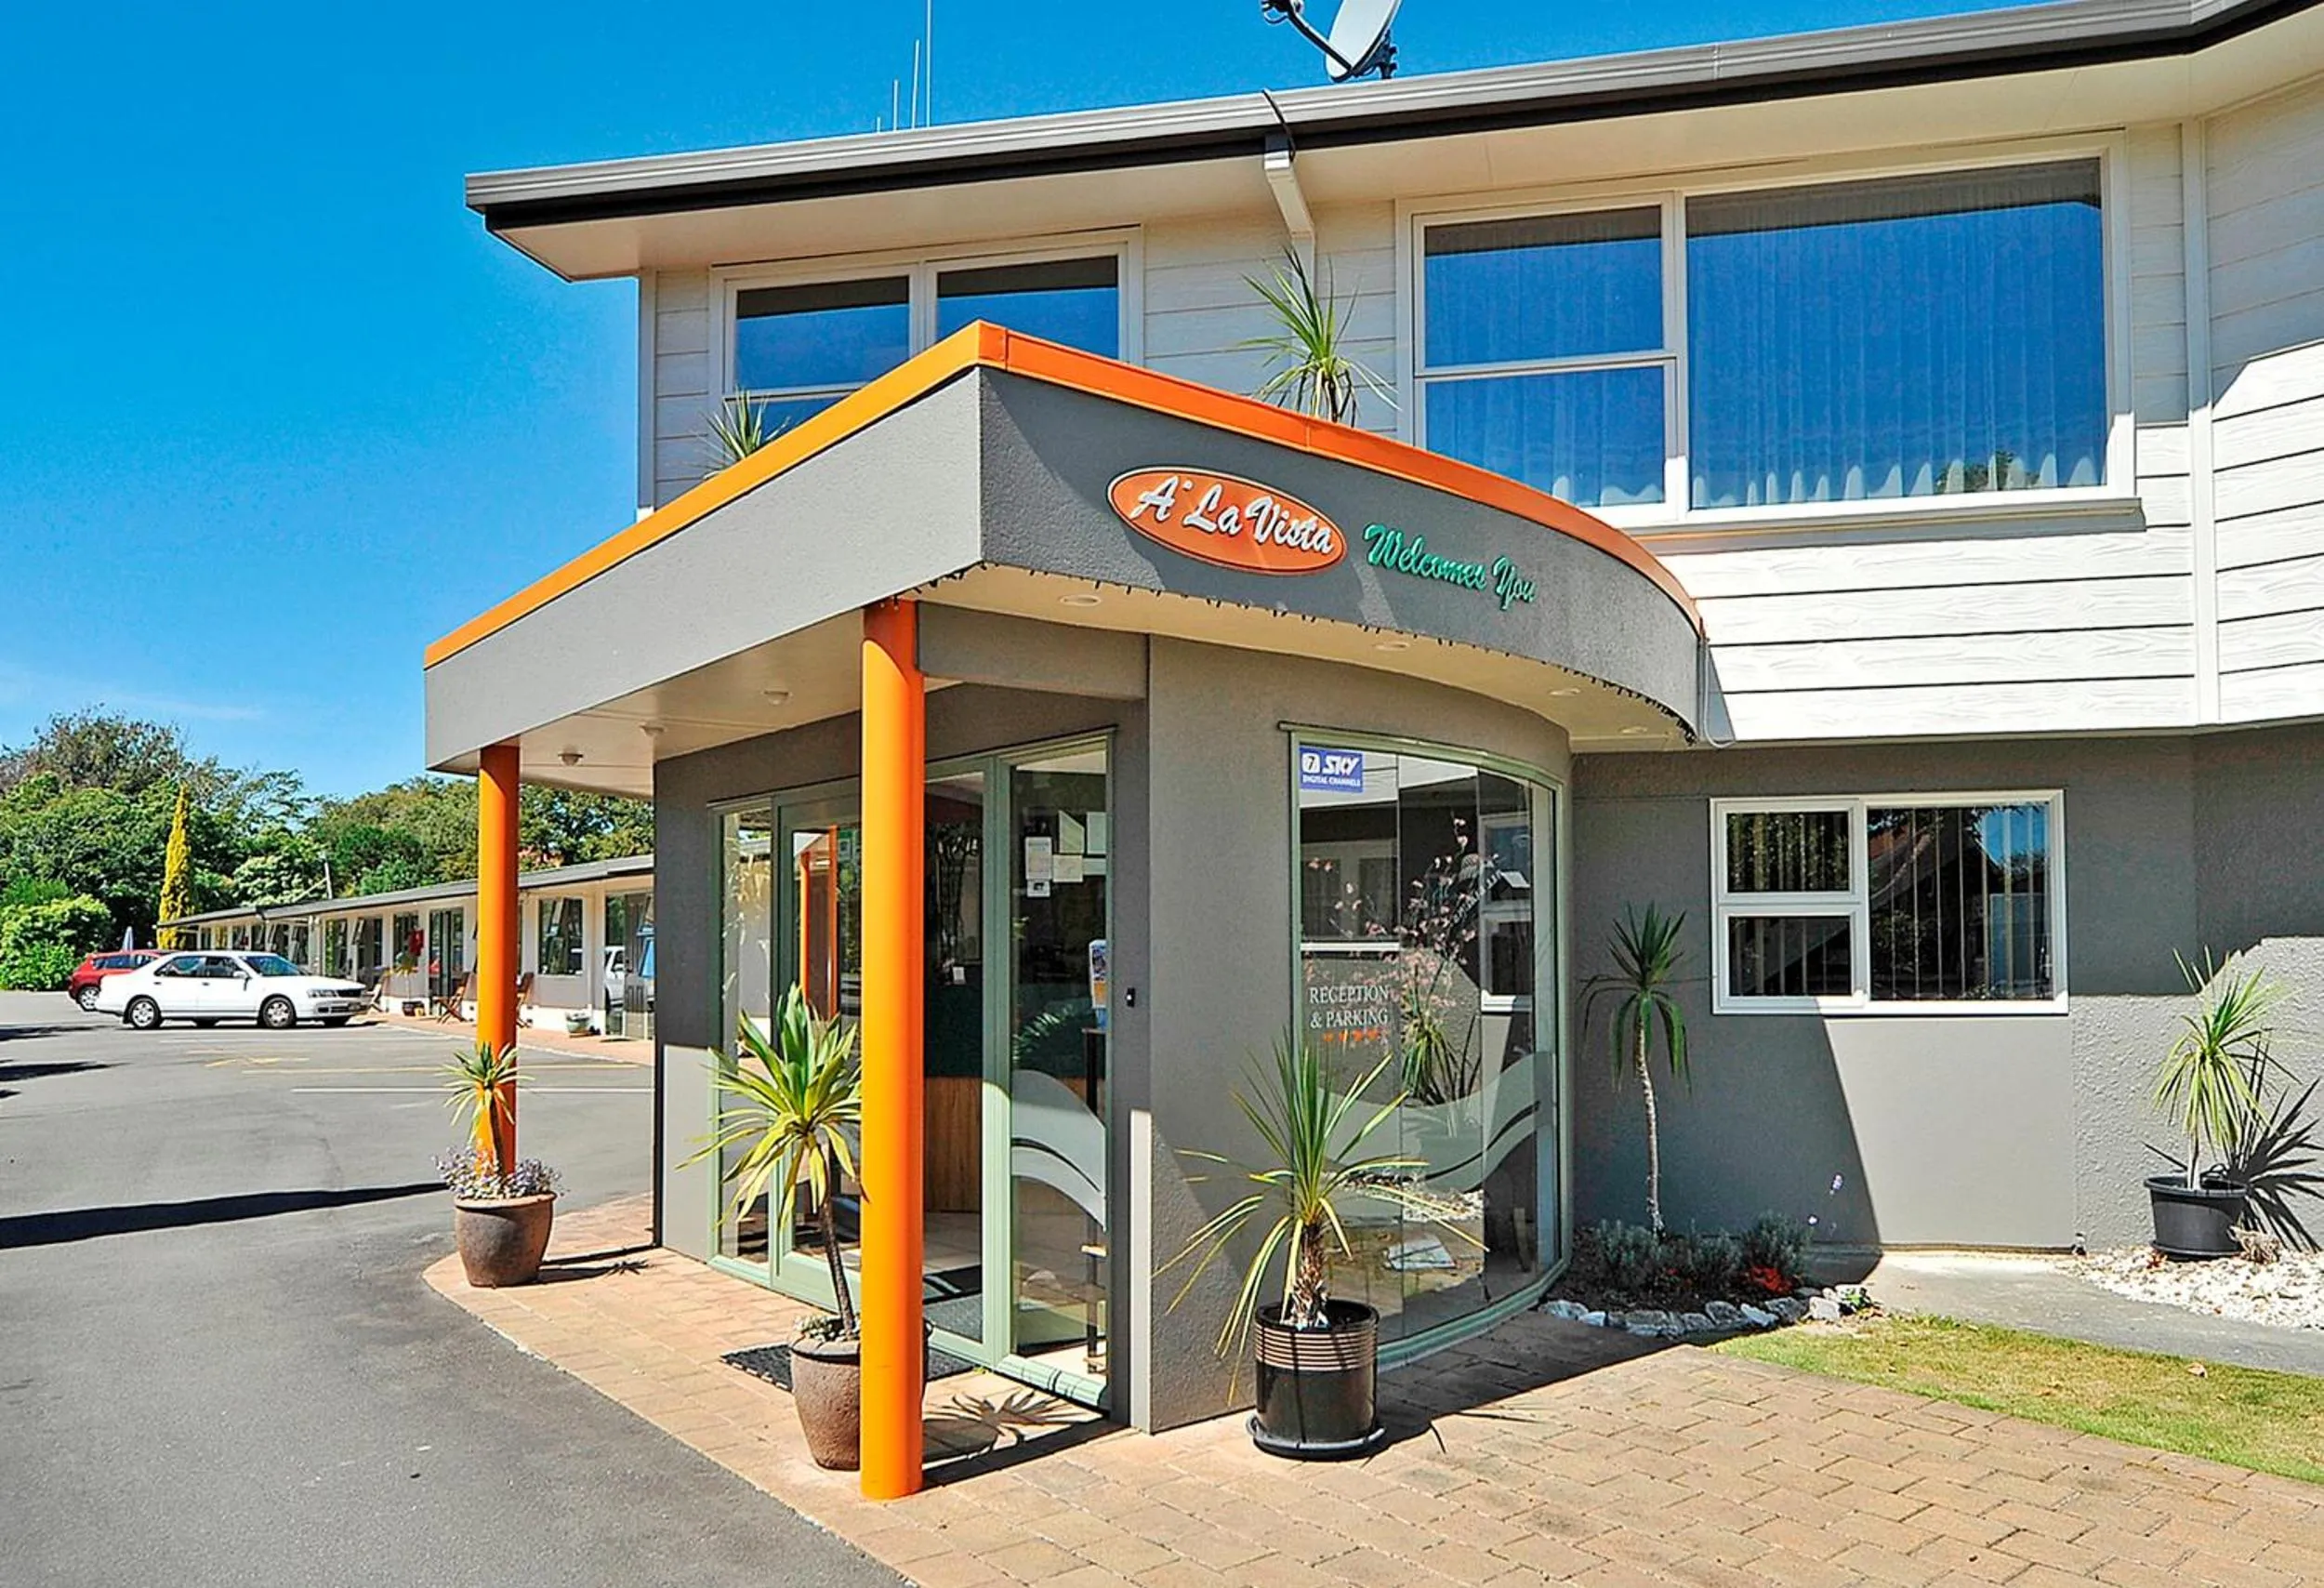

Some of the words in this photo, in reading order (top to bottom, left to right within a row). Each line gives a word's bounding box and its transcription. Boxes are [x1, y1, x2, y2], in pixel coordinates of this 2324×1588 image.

[1182, 483, 1243, 536] La
[1245, 496, 1334, 555] Vista
[1363, 522, 1487, 590] Welcomes
[1491, 556, 1536, 611] You
[1321, 754, 1360, 775] SKY
[1309, 985, 1390, 1004] RECEPTION
[1309, 1011, 1322, 1029] &
[1326, 1007, 1389, 1027] PARKING
